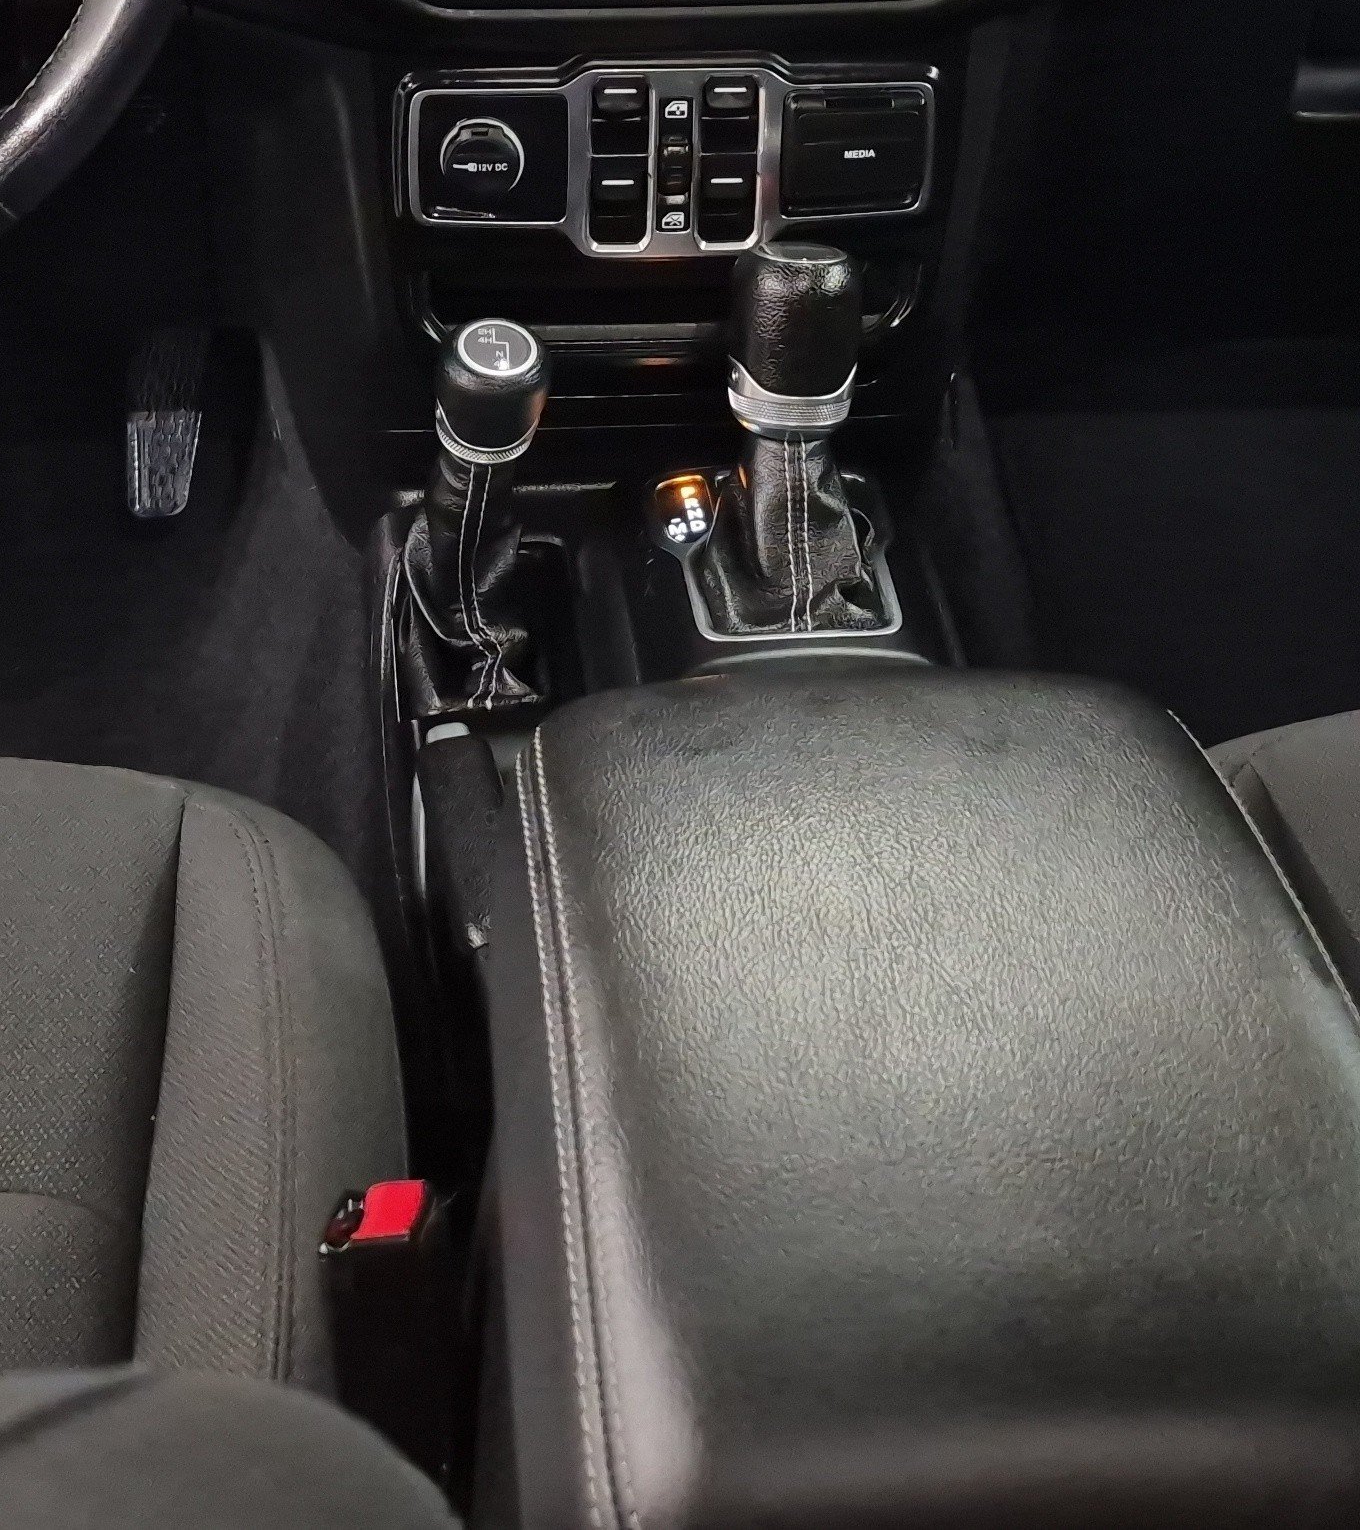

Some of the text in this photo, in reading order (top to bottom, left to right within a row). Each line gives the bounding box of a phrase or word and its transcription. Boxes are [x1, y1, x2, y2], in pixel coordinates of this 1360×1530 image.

[844, 149, 876, 159] MEDIA
[478, 162, 509, 172] 12V DC
[477, 336, 493, 345] 4H
[495, 350, 504, 358] N
[680, 486, 696, 499] P
[684, 497, 700, 509] R
[686, 507, 704, 520] N
[668, 522, 688, 536] M
[689, 520, 707, 533] D
